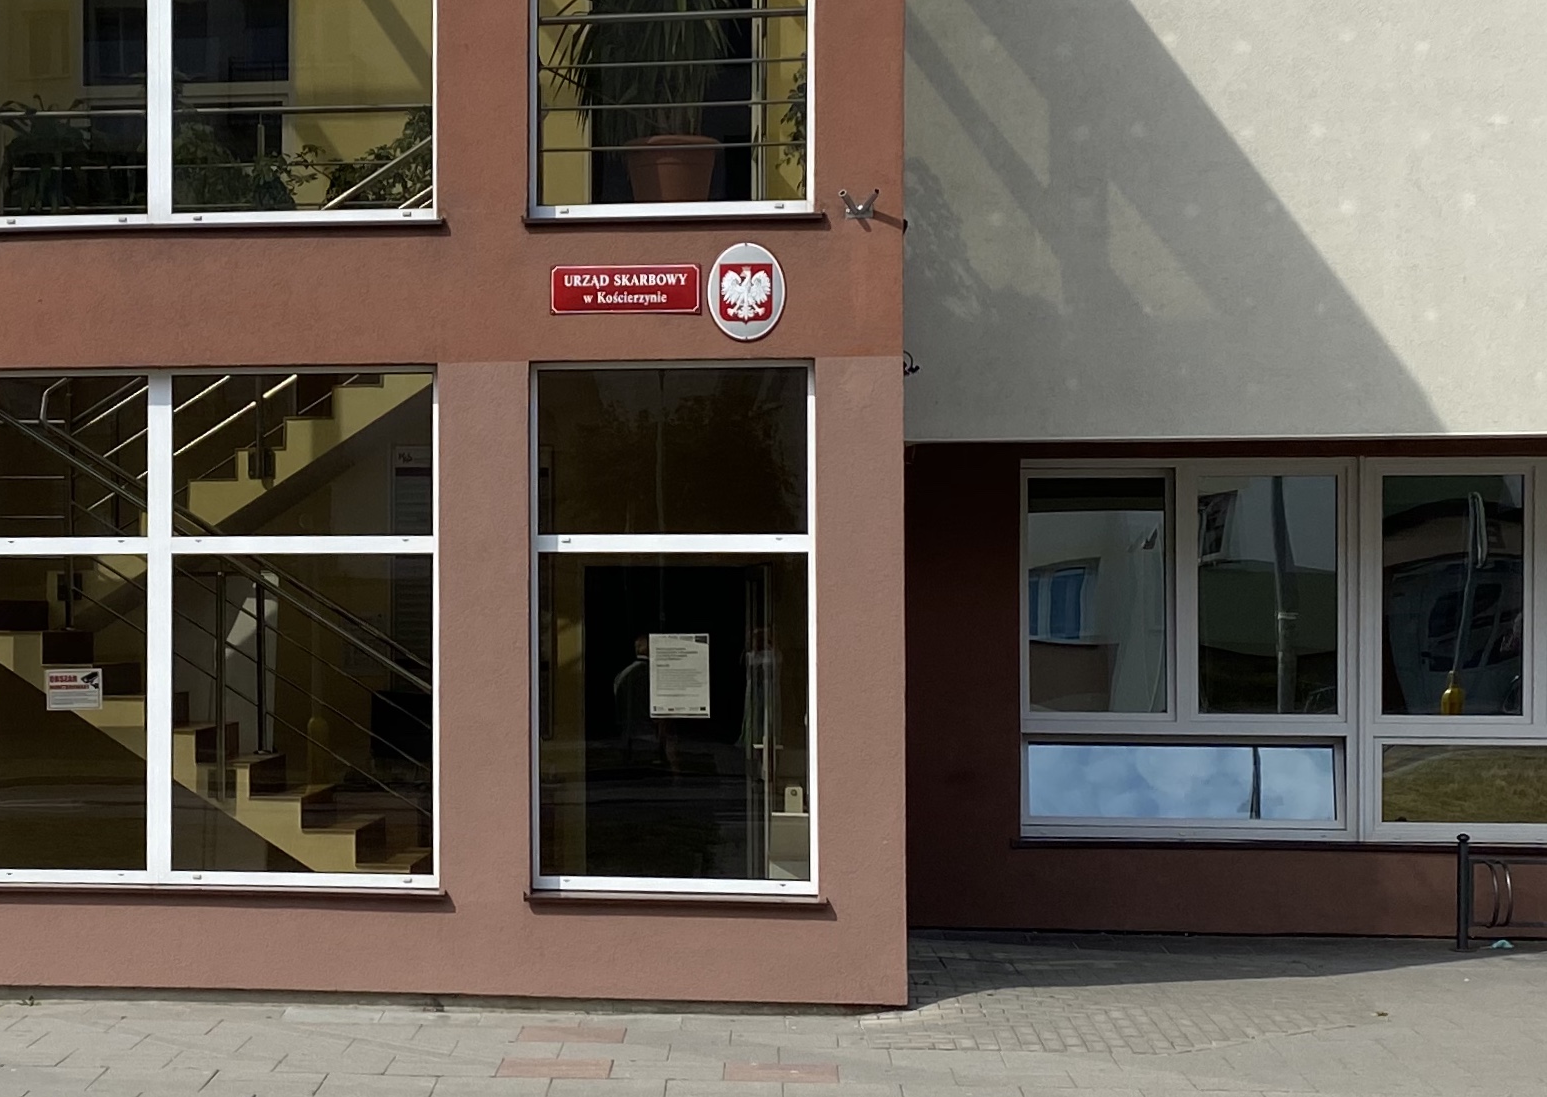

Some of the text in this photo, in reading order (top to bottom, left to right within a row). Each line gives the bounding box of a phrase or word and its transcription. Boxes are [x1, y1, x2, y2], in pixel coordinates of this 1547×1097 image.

[564, 274, 687, 289] URZĄD SKARBOWY
[583, 291, 667, 305] w Kościerzynie
